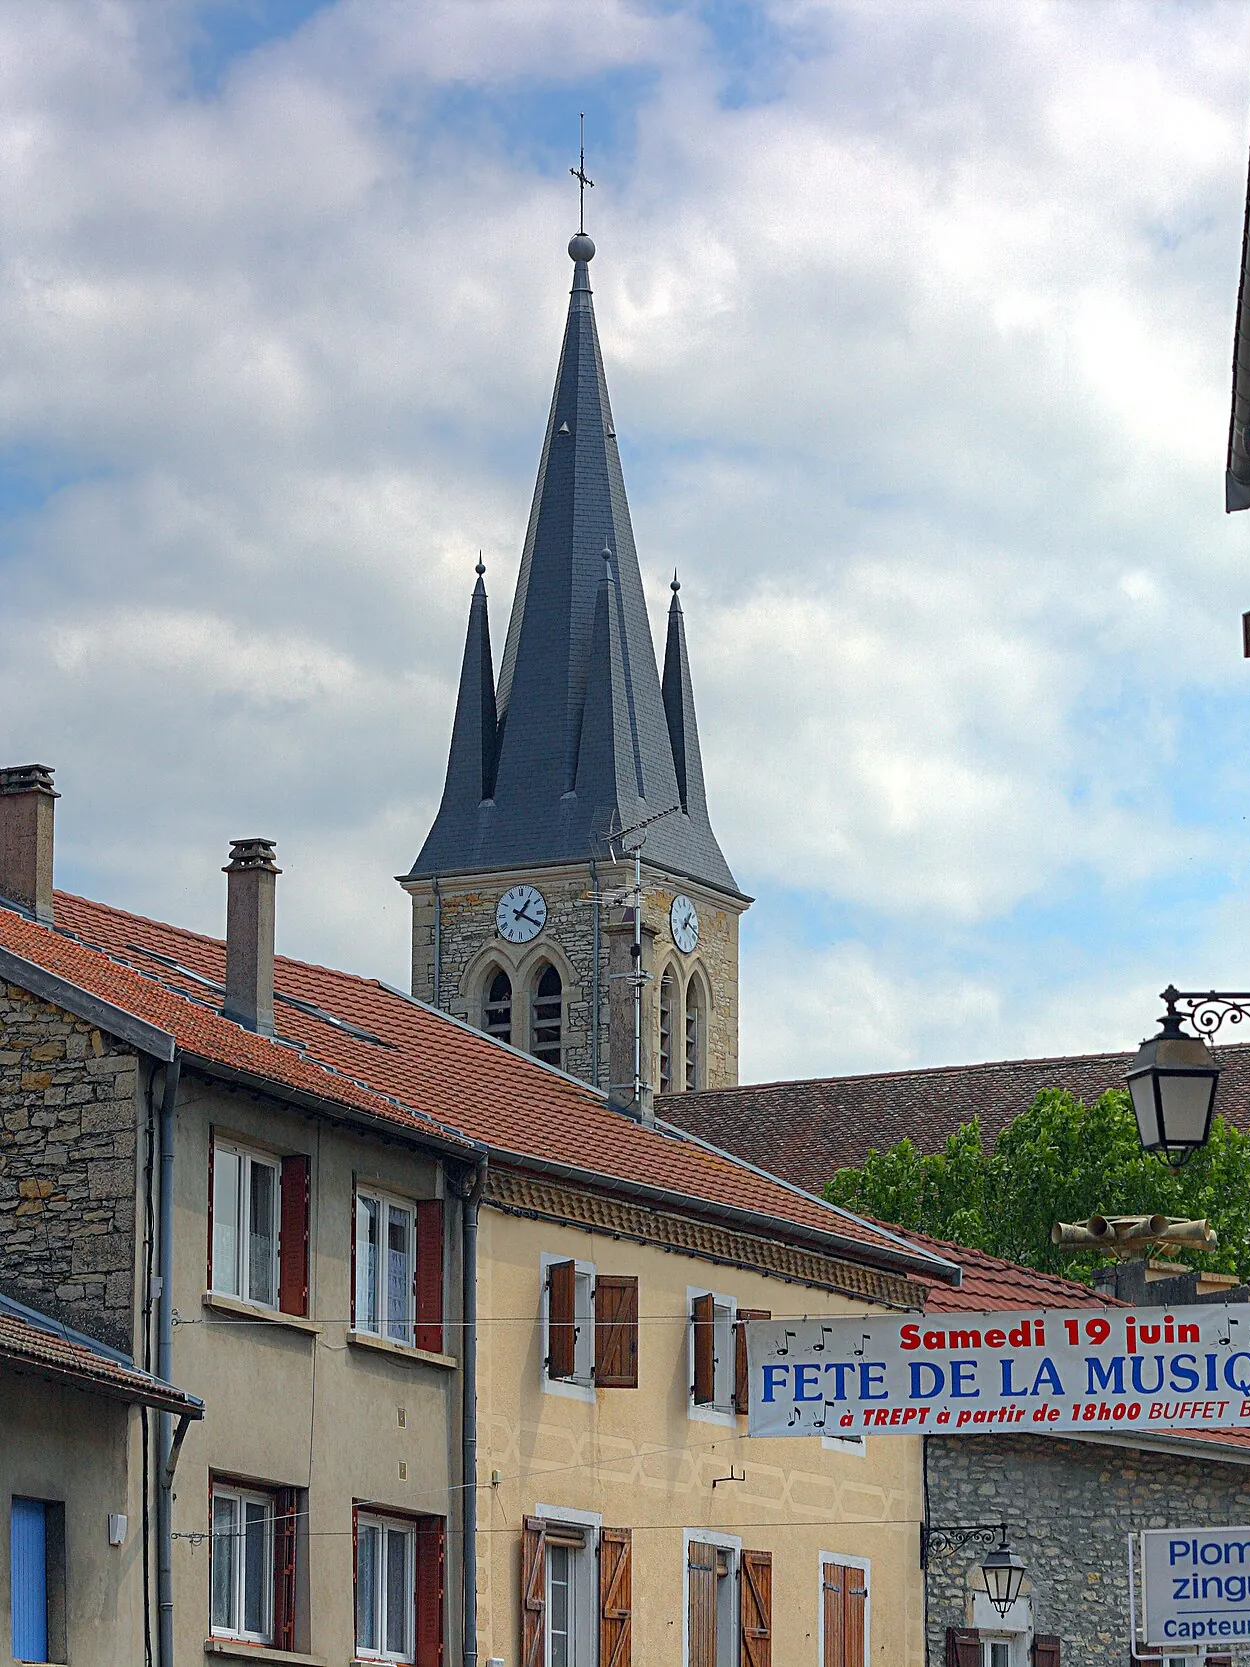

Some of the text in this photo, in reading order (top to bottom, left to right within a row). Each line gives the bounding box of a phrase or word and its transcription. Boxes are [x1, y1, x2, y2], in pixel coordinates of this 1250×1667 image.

[900, 1315, 1200, 1353] Samedi 19 juin
[761, 1362, 889, 1403] FETE
[908, 1360, 980, 1399] DE
[1000, 1357, 1066, 1396] LA
[839, 1408, 855, 1427] à
[863, 1407, 931, 1427] TREPT
[936, 1406, 951, 1424] à
[956, 1404, 1026, 1428] partir
[1033, 1402, 1060, 1422] de
[1071, 1402, 1142, 1422] 18h00
[1148, 1401, 1229, 1420] BUFFET
